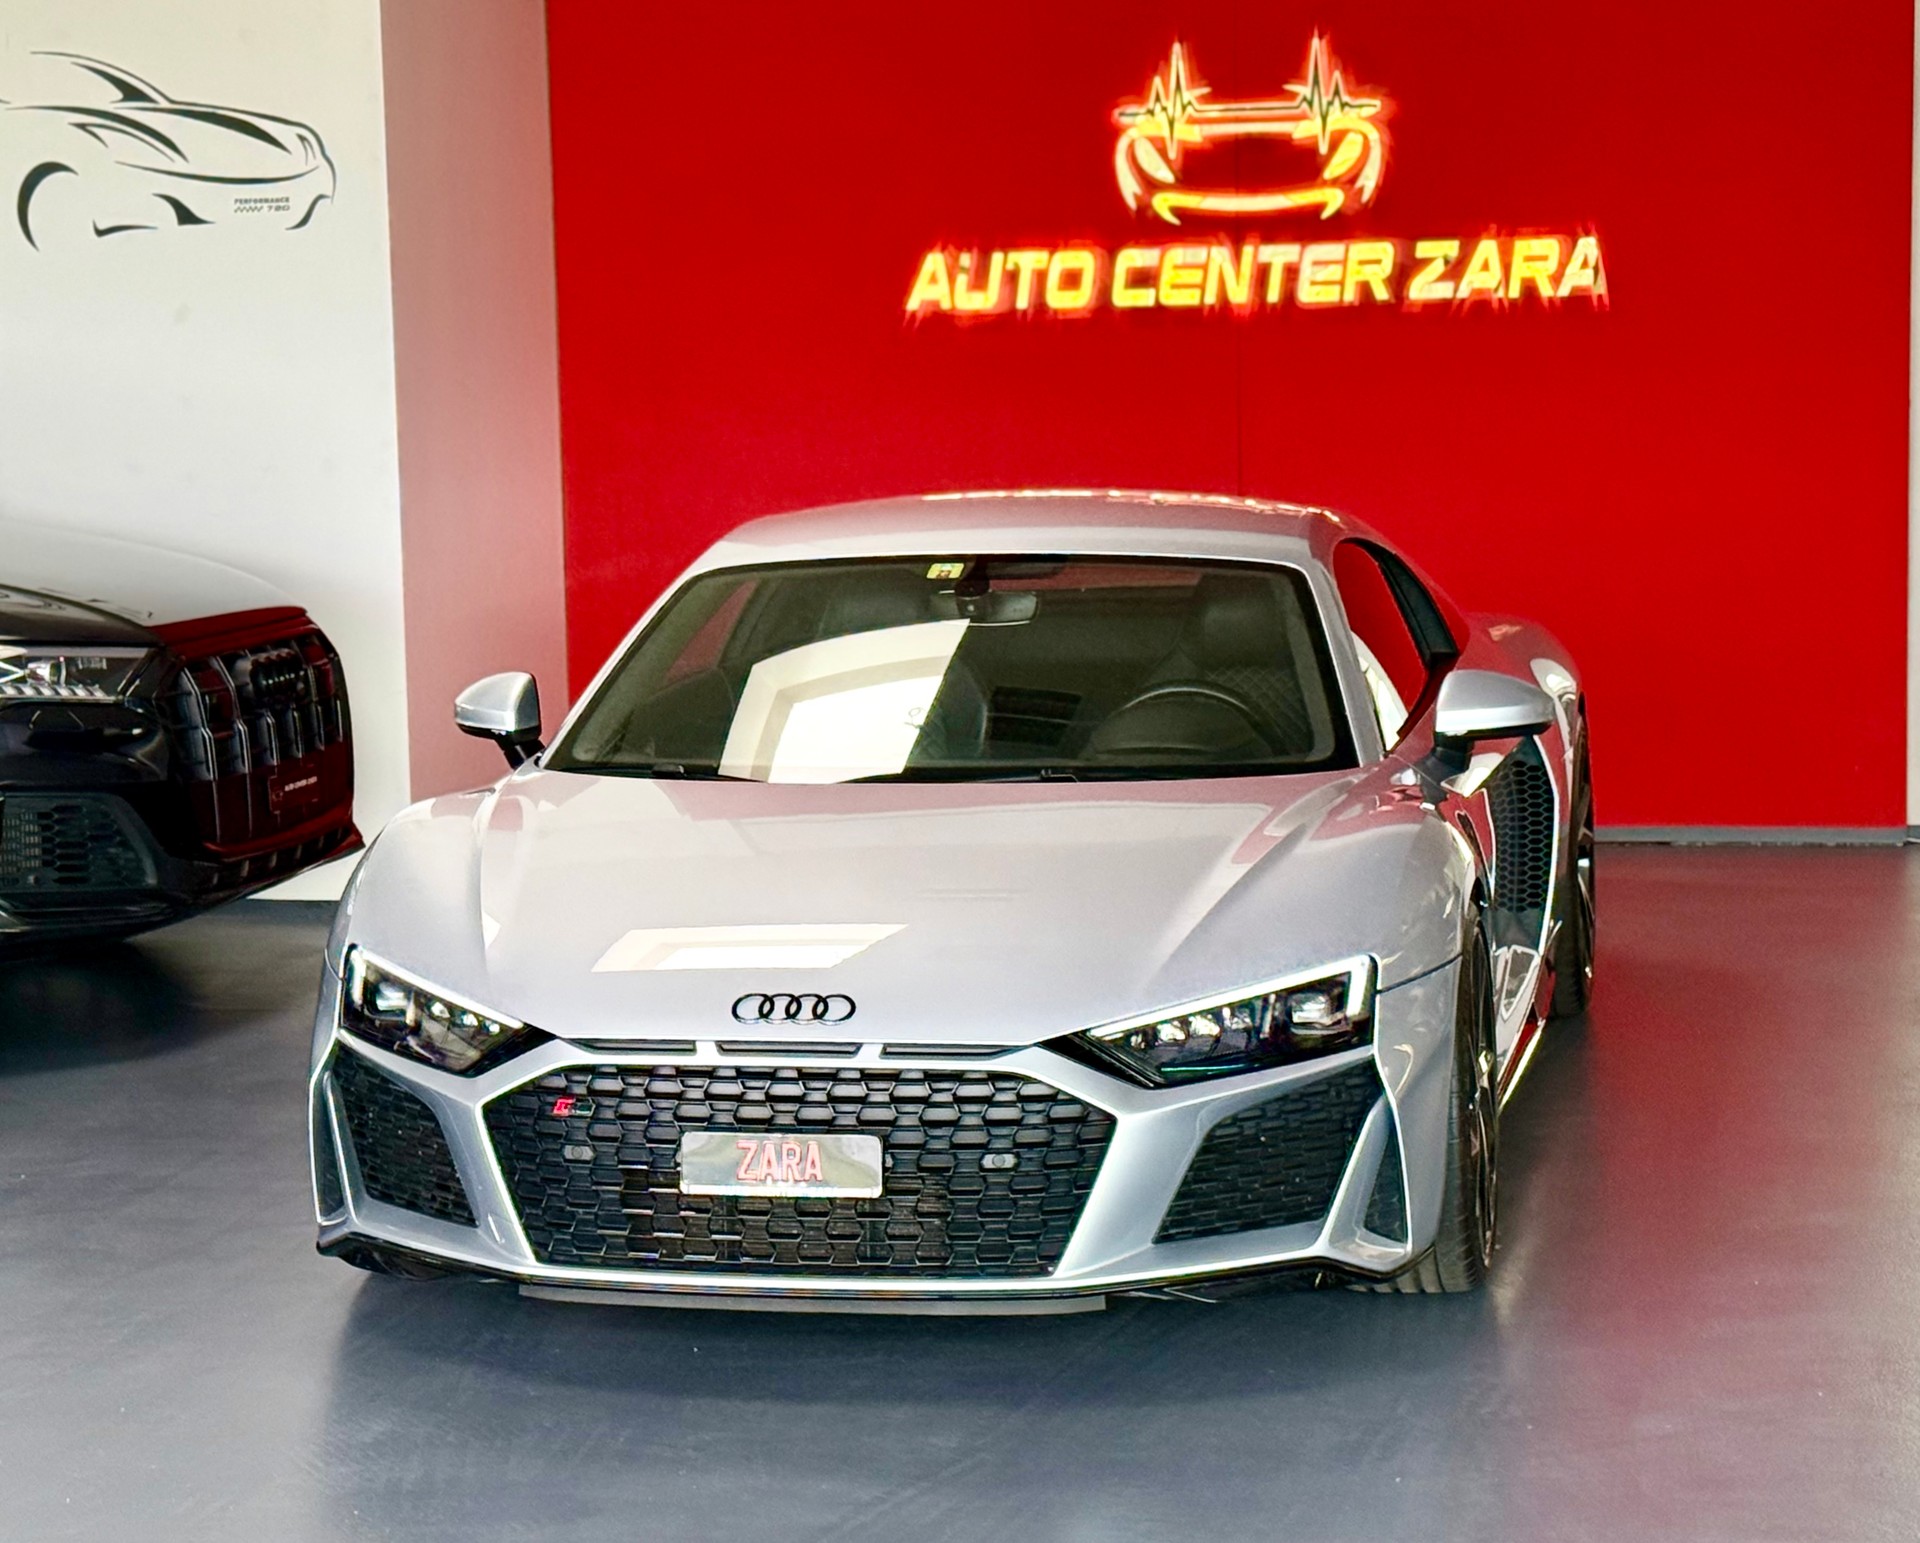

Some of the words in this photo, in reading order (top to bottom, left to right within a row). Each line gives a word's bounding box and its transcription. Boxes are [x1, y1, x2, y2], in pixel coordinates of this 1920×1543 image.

[233, 197, 290, 205] PERFORMANCE
[905, 249, 1096, 311] AUTO
[1111, 242, 1395, 309] CENTER
[1408, 237, 1604, 300] ZARA
[735, 1139, 824, 1182] ZARA
